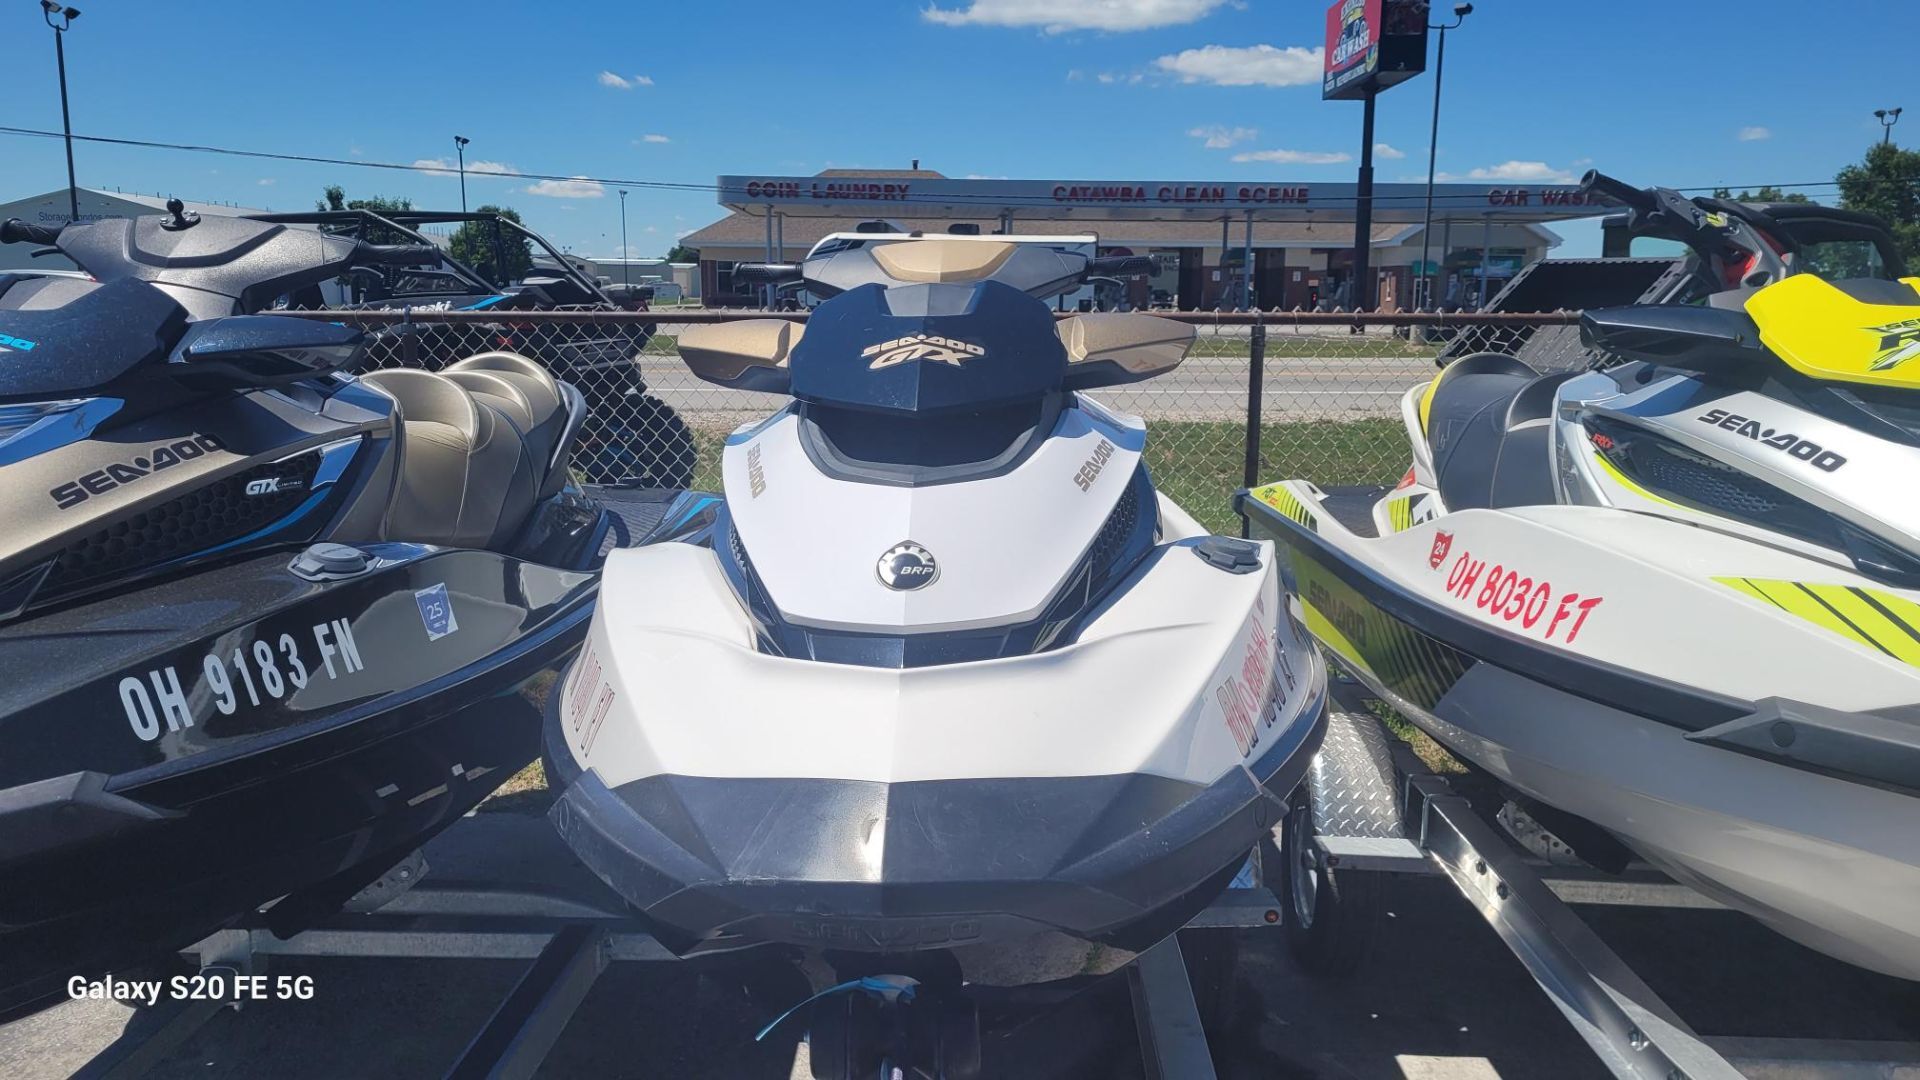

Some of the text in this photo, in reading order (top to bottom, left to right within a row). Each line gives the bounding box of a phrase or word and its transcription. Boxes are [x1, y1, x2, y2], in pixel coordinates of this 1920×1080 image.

[746, 181, 910, 200] COIN LAUNDRY
[1053, 186, 1309, 203] CATAWBA CLEAN SCENE
[1488, 189, 1528, 206] CAR
[869, 344, 975, 369] GTX
[246, 478, 281, 495] GTX
[901, 566, 934, 576] BRP
[1447, 552, 1603, 643] OH 8030 FT
[427, 601, 443, 620] 25
[119, 617, 364, 741] OH 9183 FN
